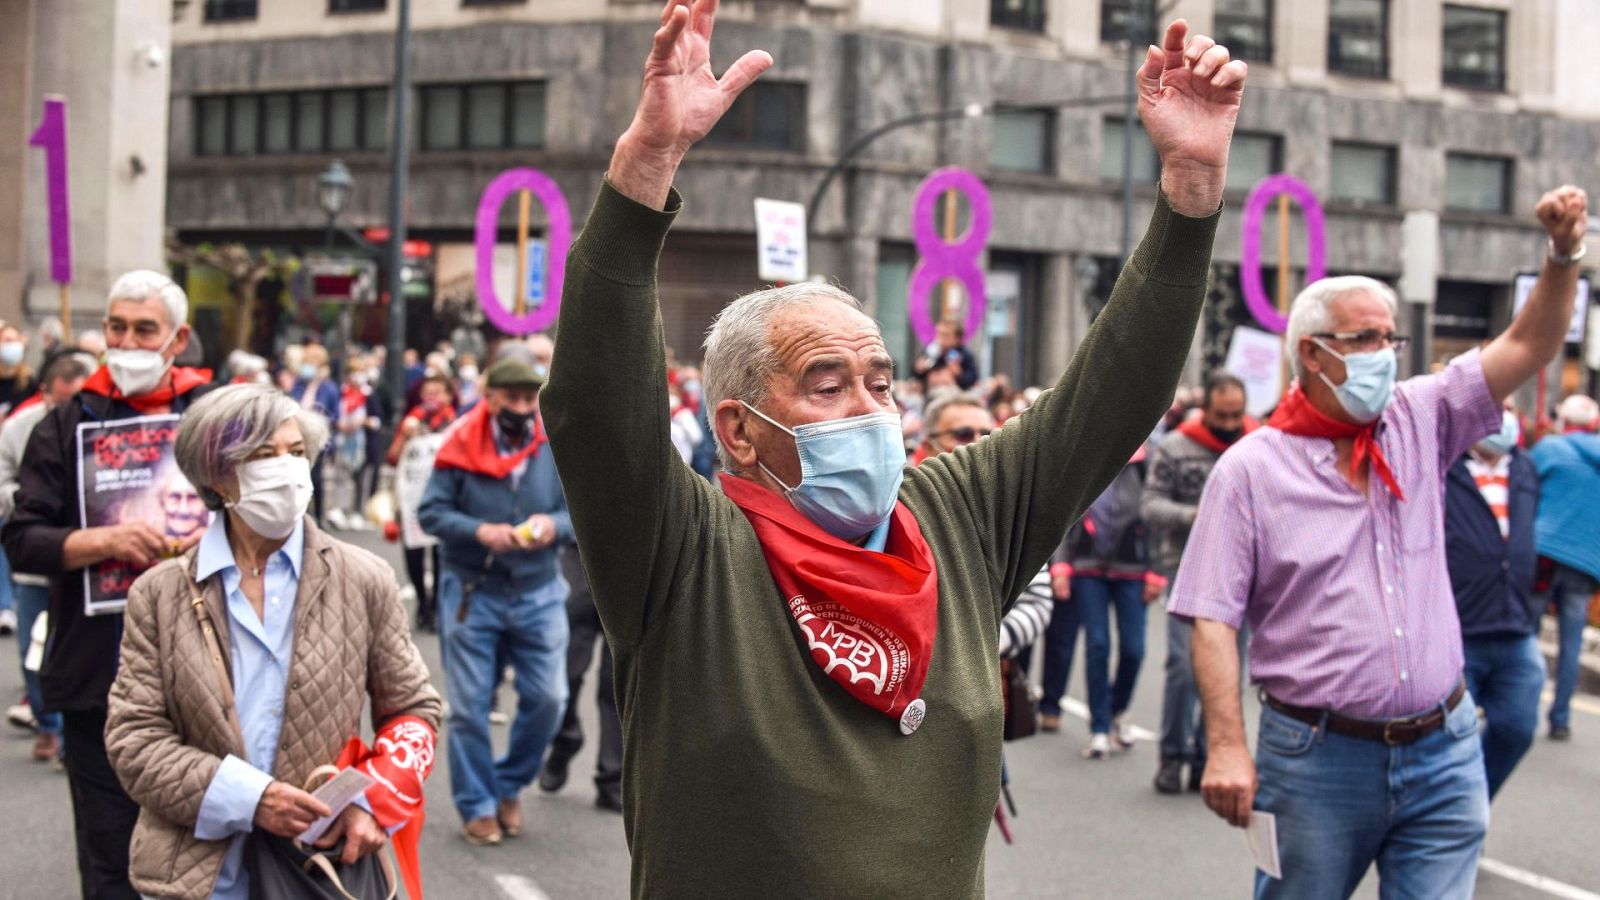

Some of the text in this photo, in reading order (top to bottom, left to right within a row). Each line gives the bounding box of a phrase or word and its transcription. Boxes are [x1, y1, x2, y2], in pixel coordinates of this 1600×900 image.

[29, 95, 1326, 346] 1 0 8 0
[820, 622, 876, 667] MPB
